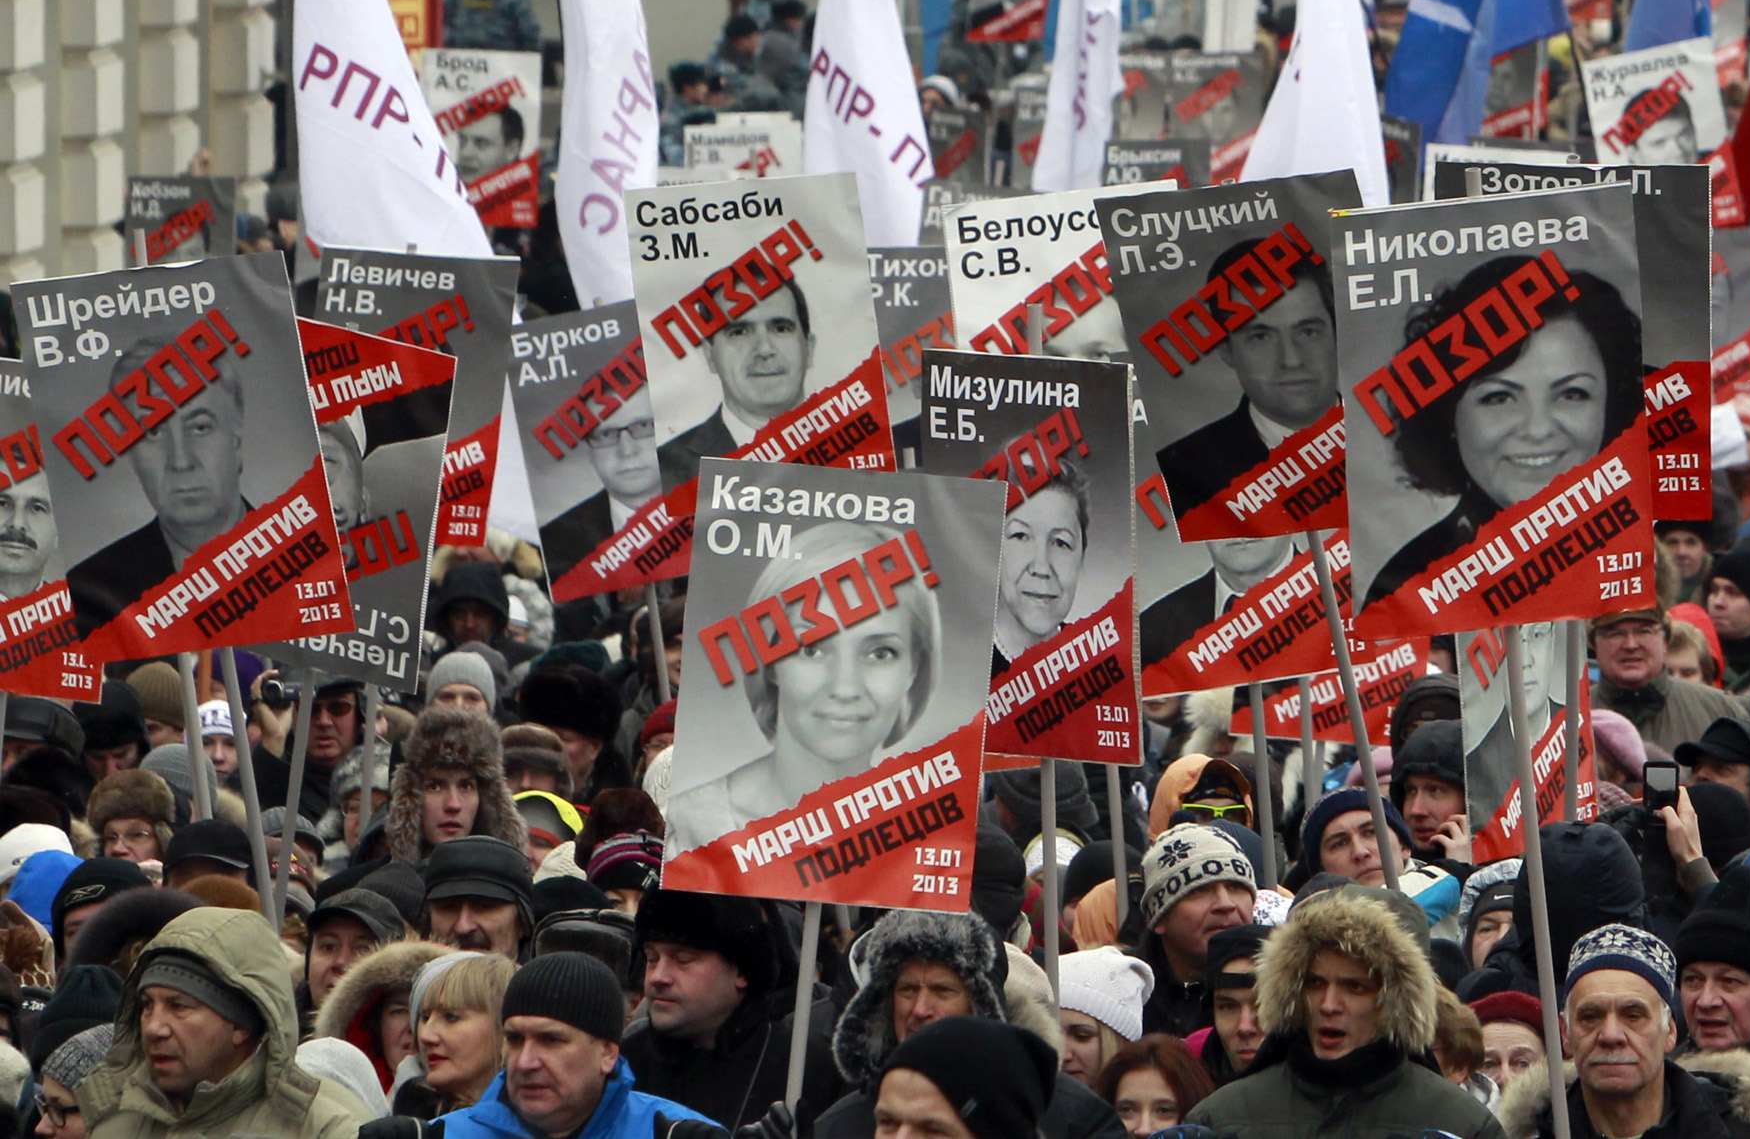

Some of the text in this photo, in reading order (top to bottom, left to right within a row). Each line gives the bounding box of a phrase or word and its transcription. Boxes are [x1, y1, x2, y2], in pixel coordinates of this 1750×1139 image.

[1595, 169, 1663, 195] ИЛ.
[635, 191, 785, 228] Сабсаби
[1110, 190, 1279, 242] Слуцкий
[640, 233, 709, 262] З.М.
[1120, 241, 1198, 276] Л.Э.
[1344, 214, 1589, 267] Николаева
[327, 258, 456, 291] Левичев
[961, 247, 1031, 280] С.В.
[27, 281, 217, 330] Шрейдер
[324, 288, 383, 315] Н.В.
[652, 219, 824, 359] ПОЗОР!
[1139, 221, 1325, 378] ПОЗОР!
[1347, 268, 1433, 310] Е.Л.
[33, 328, 124, 368] В.Ф.
[511, 318, 620, 359] Бурков
[1353, 248, 1581, 437] ПОЗОР!
[517, 355, 578, 387] А.Л.
[929, 364, 1080, 412] Мизулина
[52, 309, 252, 481] ПОЗОР!
[533, 336, 647, 460] ПОЗО
[782, 380, 873, 453] ПРОТИВ
[929, 406, 985, 443] Е.Б.
[443, 441, 486, 476] ТИВ
[848, 453, 886, 470] 13.01
[969, 407, 1090, 510] ЗОР!
[1225, 457, 1305, 523] МАРШ
[1296, 425, 1345, 471] ПРО
[1655, 453, 1700, 470] 13.01
[711, 474, 917, 525] Казакова
[1657, 476, 1701, 493] 2013
[448, 522, 479, 537] 2013
[450, 505, 481, 519] 13.01
[591, 520, 654, 581] МАРШ
[635, 510, 699, 576] ПОДЛЕ
[706, 519, 803, 560] О.М.
[1417, 456, 1634, 615] МАРШ ПРОТИВ
[134, 570, 220, 639] МАРШ
[212, 493, 320, 577] ПРОТИВ
[1481, 496, 1641, 618] ПОДЛЕЦОВ
[1597, 551, 1643, 573] 13.01
[194, 530, 330, 640] ПОДЛЕЦОВ
[294, 580, 337, 600] 13.01
[1599, 576, 1643, 600] 2013
[7, 587, 72, 636] ПРОТИ
[299, 603, 341, 624] 2013
[699, 529, 941, 686] ПОЗОР!
[1187, 608, 1264, 673] МАРШ
[61, 672, 93, 690] 2013
[986, 615, 1121, 726] АРШ ПРОТИВ
[1338, 643, 1417, 694] РОТИВ
[1013, 654, 1126, 745] ПОДЛЕЦОВ
[1096, 704, 1129, 724] 13.01
[1097, 729, 1130, 749] 2013
[1577, 781, 1594, 800] 3.01
[731, 751, 962, 875] МАРШ ПРОТИВ
[1500, 787, 1522, 839] МАР
[794, 792, 966, 888] ПОДЛЕЦОВ
[914, 846, 962, 868] 13.01
[912, 873, 960, 896] 2013
